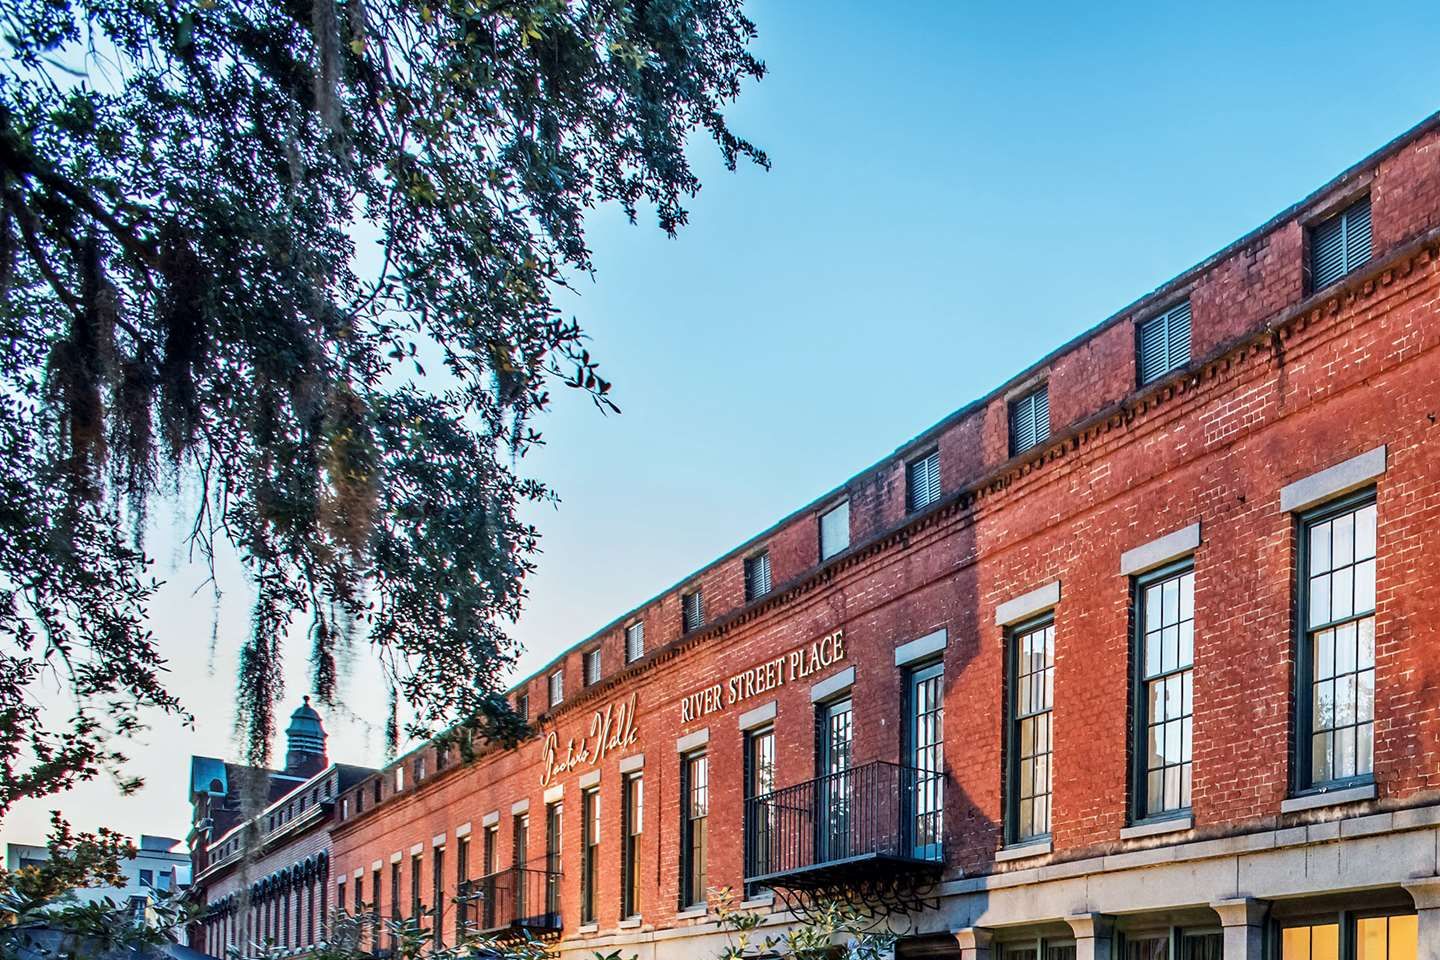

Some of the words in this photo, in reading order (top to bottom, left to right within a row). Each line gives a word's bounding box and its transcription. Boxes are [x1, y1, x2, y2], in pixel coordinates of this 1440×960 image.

[680, 683, 723, 724] RIVER
[728, 655, 786, 705] STREET
[789, 630, 845, 681] PLACE
[590, 692, 638, 765] Walk
